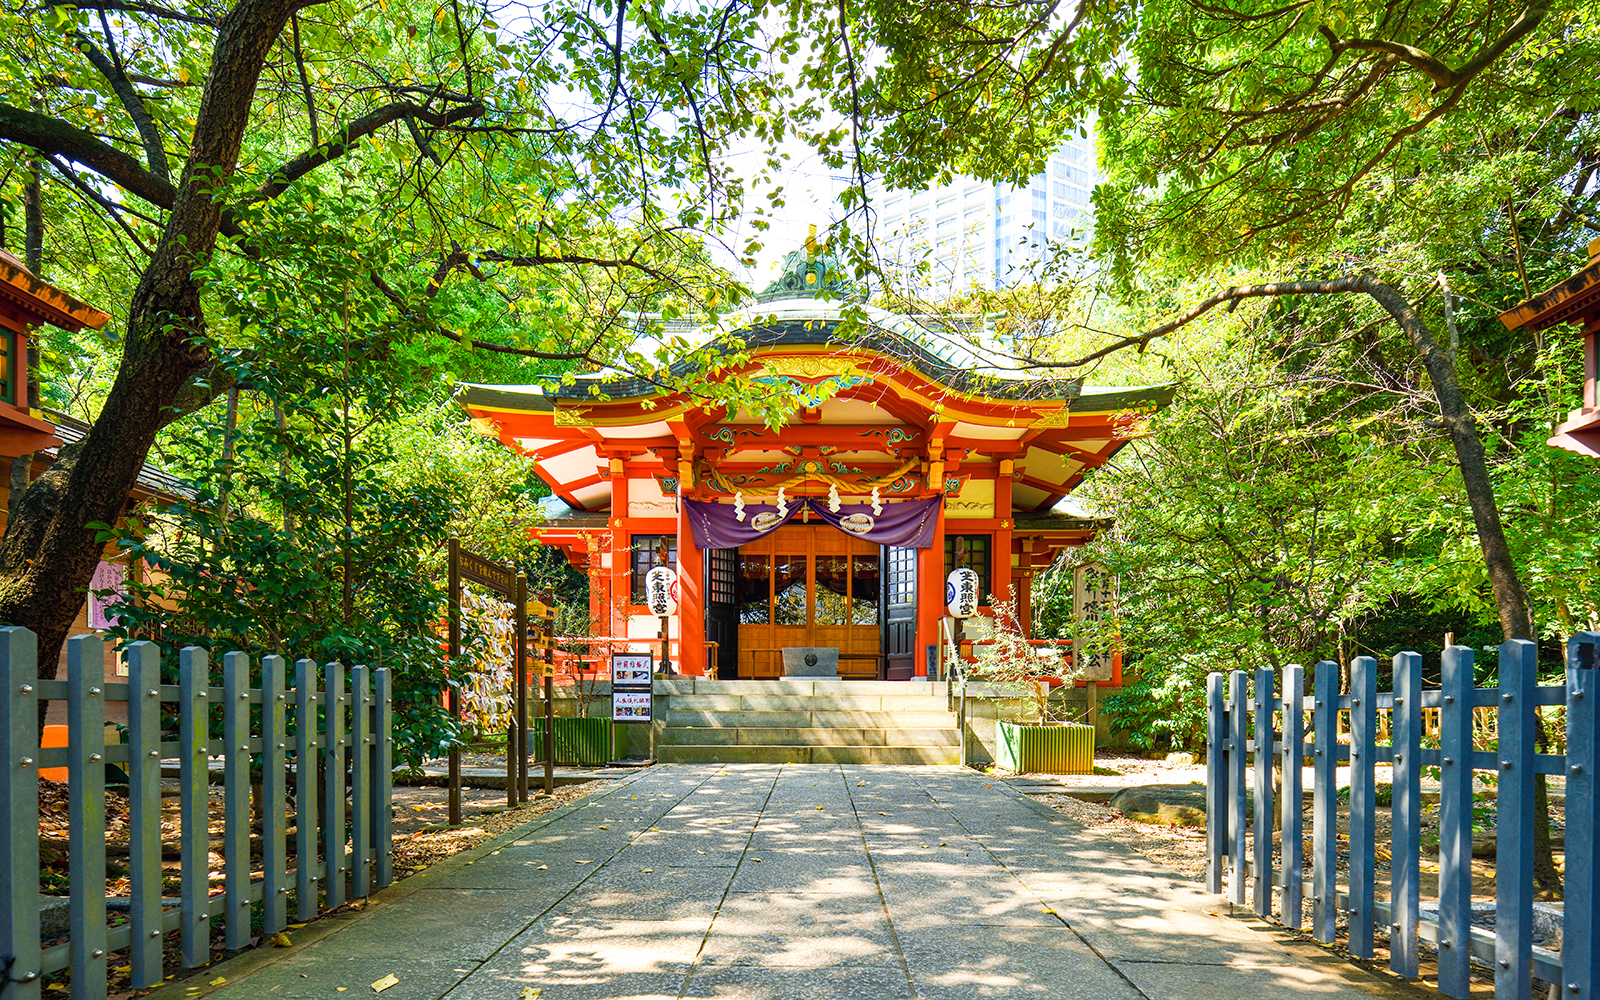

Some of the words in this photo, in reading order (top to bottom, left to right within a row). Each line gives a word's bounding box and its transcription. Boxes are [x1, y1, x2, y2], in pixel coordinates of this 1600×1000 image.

[651, 570, 668, 614] 芝東照宮
[959, 571, 974, 615] 芝東照宮
